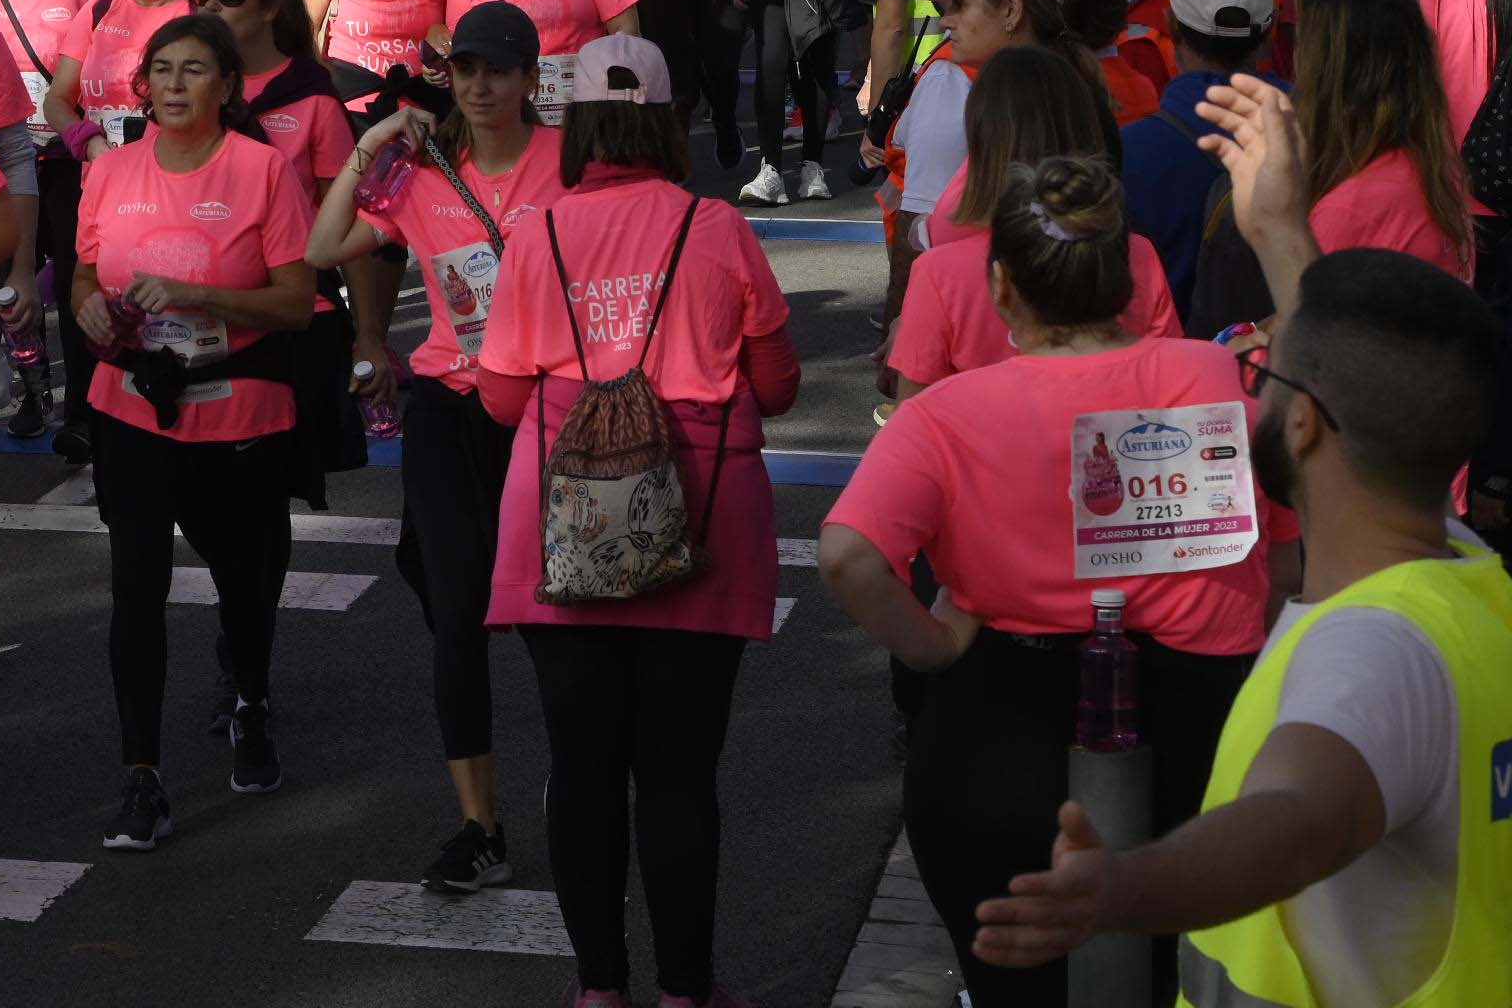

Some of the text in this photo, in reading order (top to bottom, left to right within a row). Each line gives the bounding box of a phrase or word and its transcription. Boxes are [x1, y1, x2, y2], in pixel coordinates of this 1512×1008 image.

[97, 24, 130, 37] OYSHO
[346, 21, 369, 37] TU
[82, 80, 105, 97] TU
[193, 207, 228, 217] ASTURIANA
[432, 204, 475, 218] OYSHO
[568, 270, 666, 302] CARRERA
[589, 295, 651, 323] DE LA
[144, 327, 189, 340] ASTURIANA
[1122, 425, 1233, 454] ASTURIANA SUMA
[1128, 473, 1188, 498] 016
[1136, 504, 1183, 520] 27213
[1094, 521, 1238, 540] CARRERA DE LA MUJER 2023
[1090, 544, 1244, 566] OYSHO Santander
